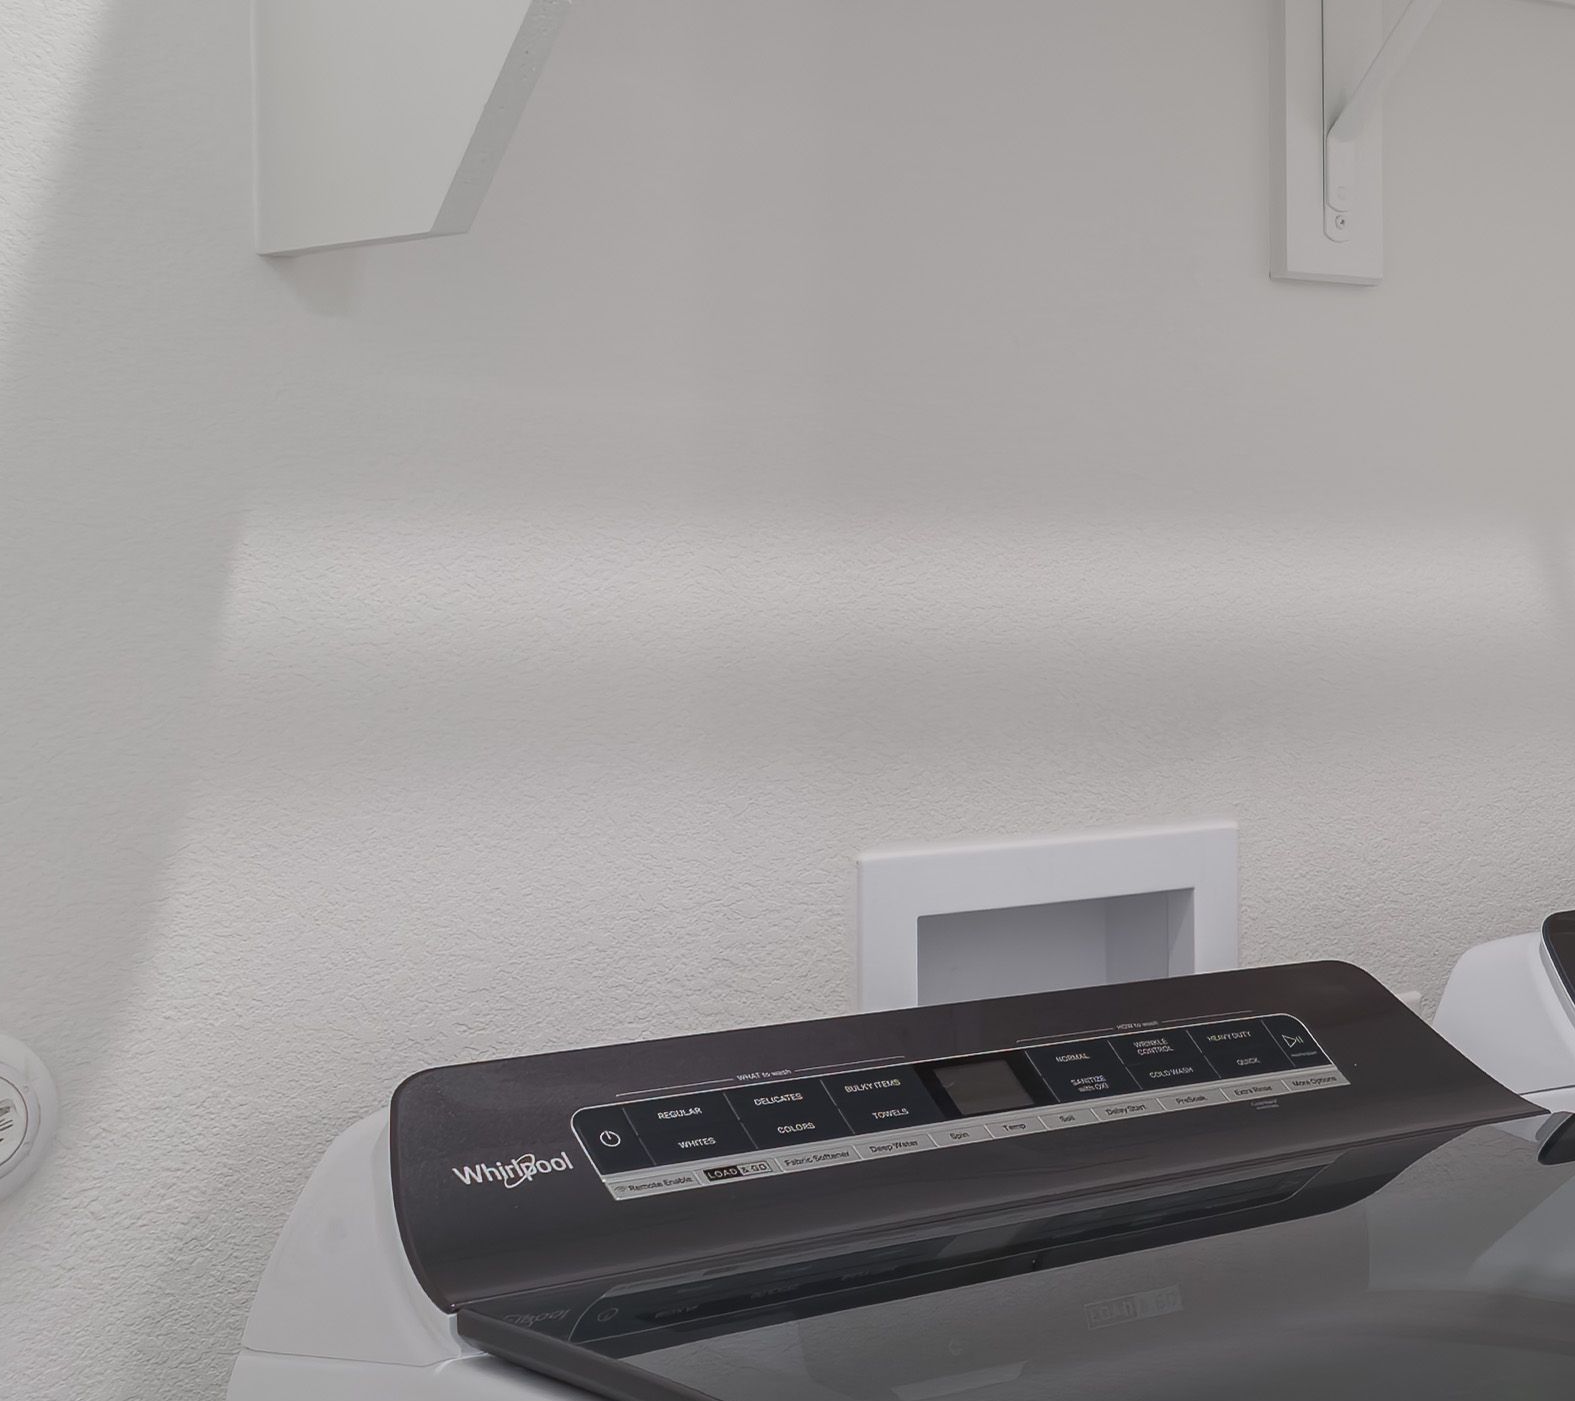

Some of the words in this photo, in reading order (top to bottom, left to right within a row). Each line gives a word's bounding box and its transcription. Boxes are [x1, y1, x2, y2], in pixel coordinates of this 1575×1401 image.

[1232, 1030, 1252, 1040] DUTY
[1055, 1052, 1090, 1064] NORMAL
[736, 1071, 761, 1081] WHAT
[761, 1071, 771, 1079] to
[771, 1068, 792, 1077] wash
[1070, 1074, 1107, 1086] SANITIZE
[1149, 1068, 1170, 1079] COLD
[844, 1081, 872, 1093] BULKY
[873, 1078, 902, 1090] ITEMS
[753, 1092, 804, 1107] DELICATES
[656, 1106, 703, 1121] REGULAR
[871, 1107, 910, 1120] TOWELS
[776, 1121, 816, 1134] COLORS
[1002, 1122, 1026, 1132] Temp
[949, 1131, 970, 1141] Spin
[677, 1136, 717, 1150] WHITES
[868, 1142, 893, 1153] Deep
[784, 1156, 812, 1167] Fabric
[812, 1150, 851, 1163] Softener
[452, 1151, 574, 1189] Whirlpool
[706, 1165, 738, 1180] LOAD
[752, 1162, 768, 1173] GO
[627, 1180, 661, 1193] Remote
[662, 1175, 694, 1188] Enable
